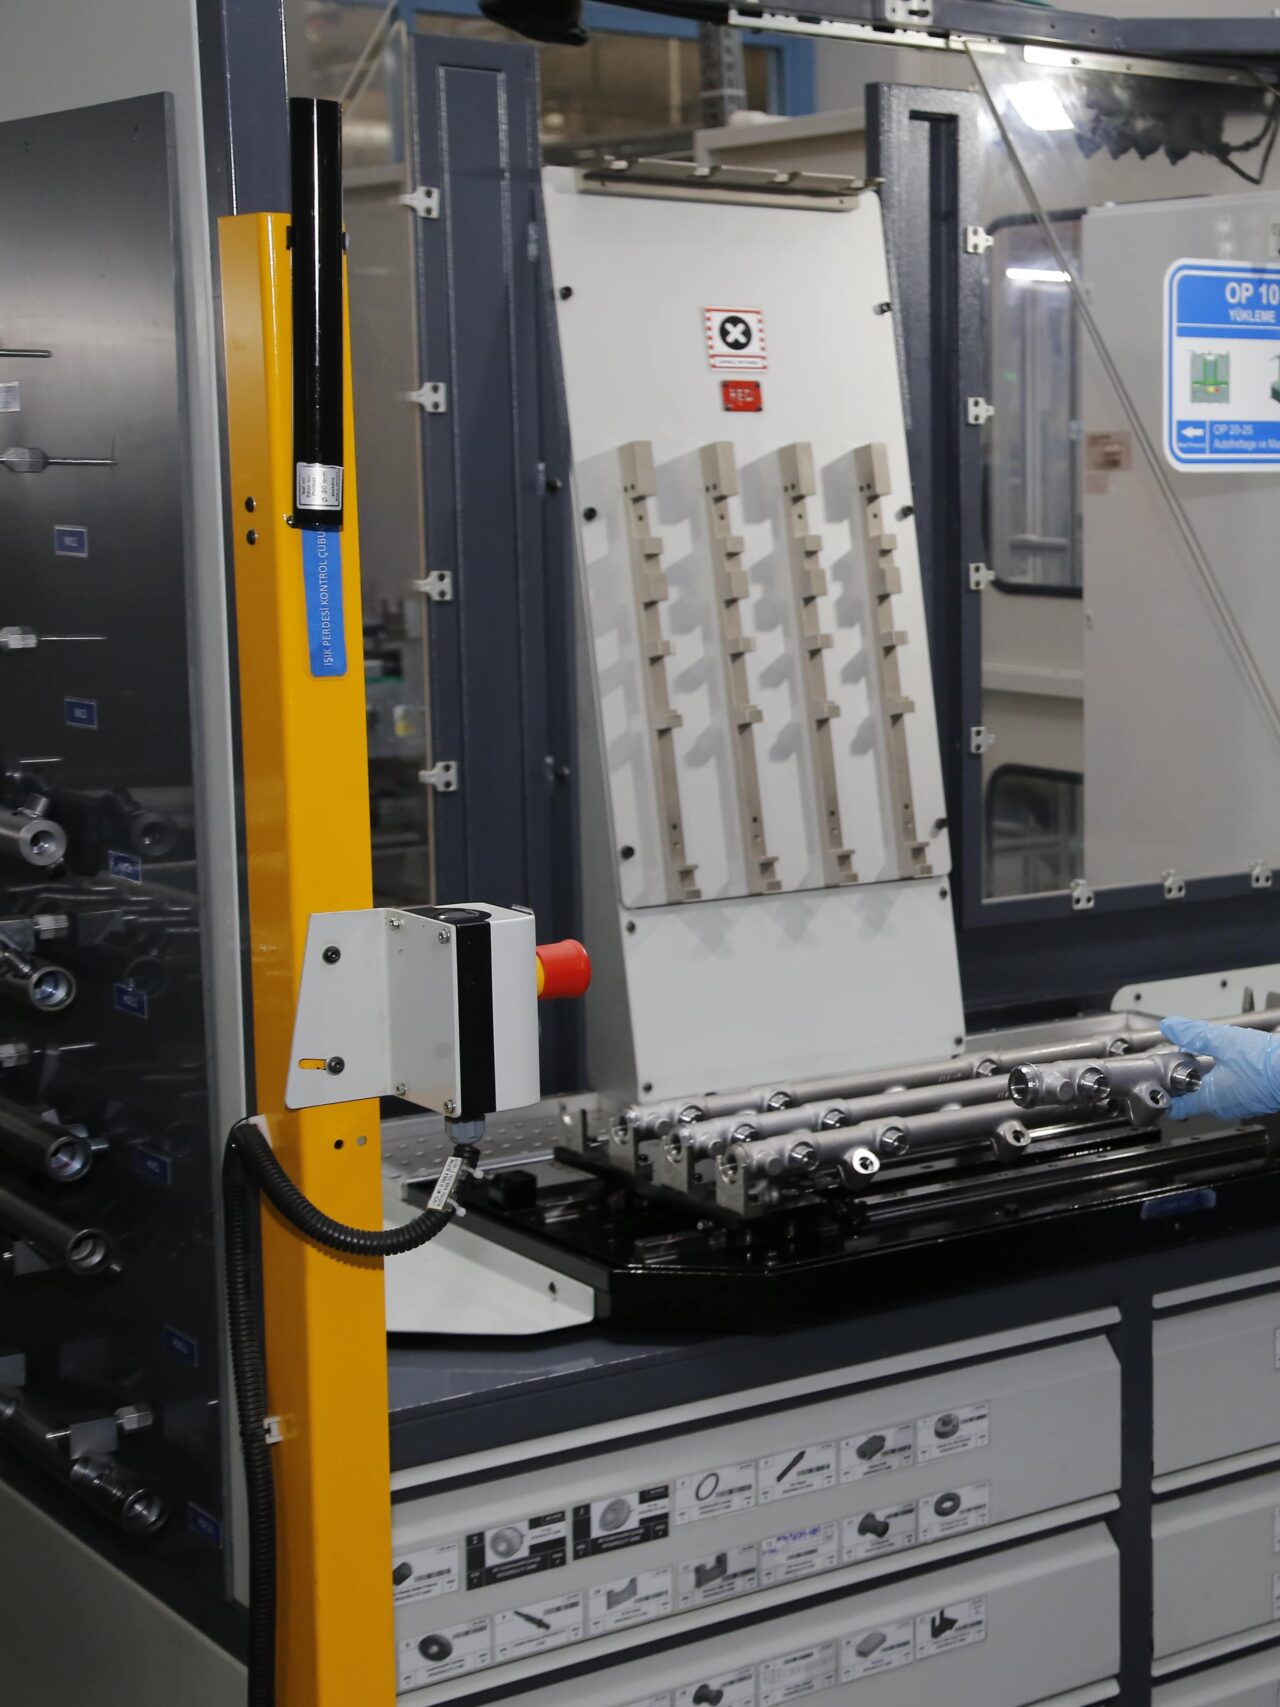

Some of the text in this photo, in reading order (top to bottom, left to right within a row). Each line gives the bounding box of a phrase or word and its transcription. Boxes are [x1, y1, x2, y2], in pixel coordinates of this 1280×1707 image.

[1225, 282, 1280, 306] OP 10
[1228, 306, 1276, 323] YÜKLEME
[1213, 424, 1227, 435] OP
[317, 530, 329, 558] ÇUBU
[319, 560, 329, 606] KONTROL
